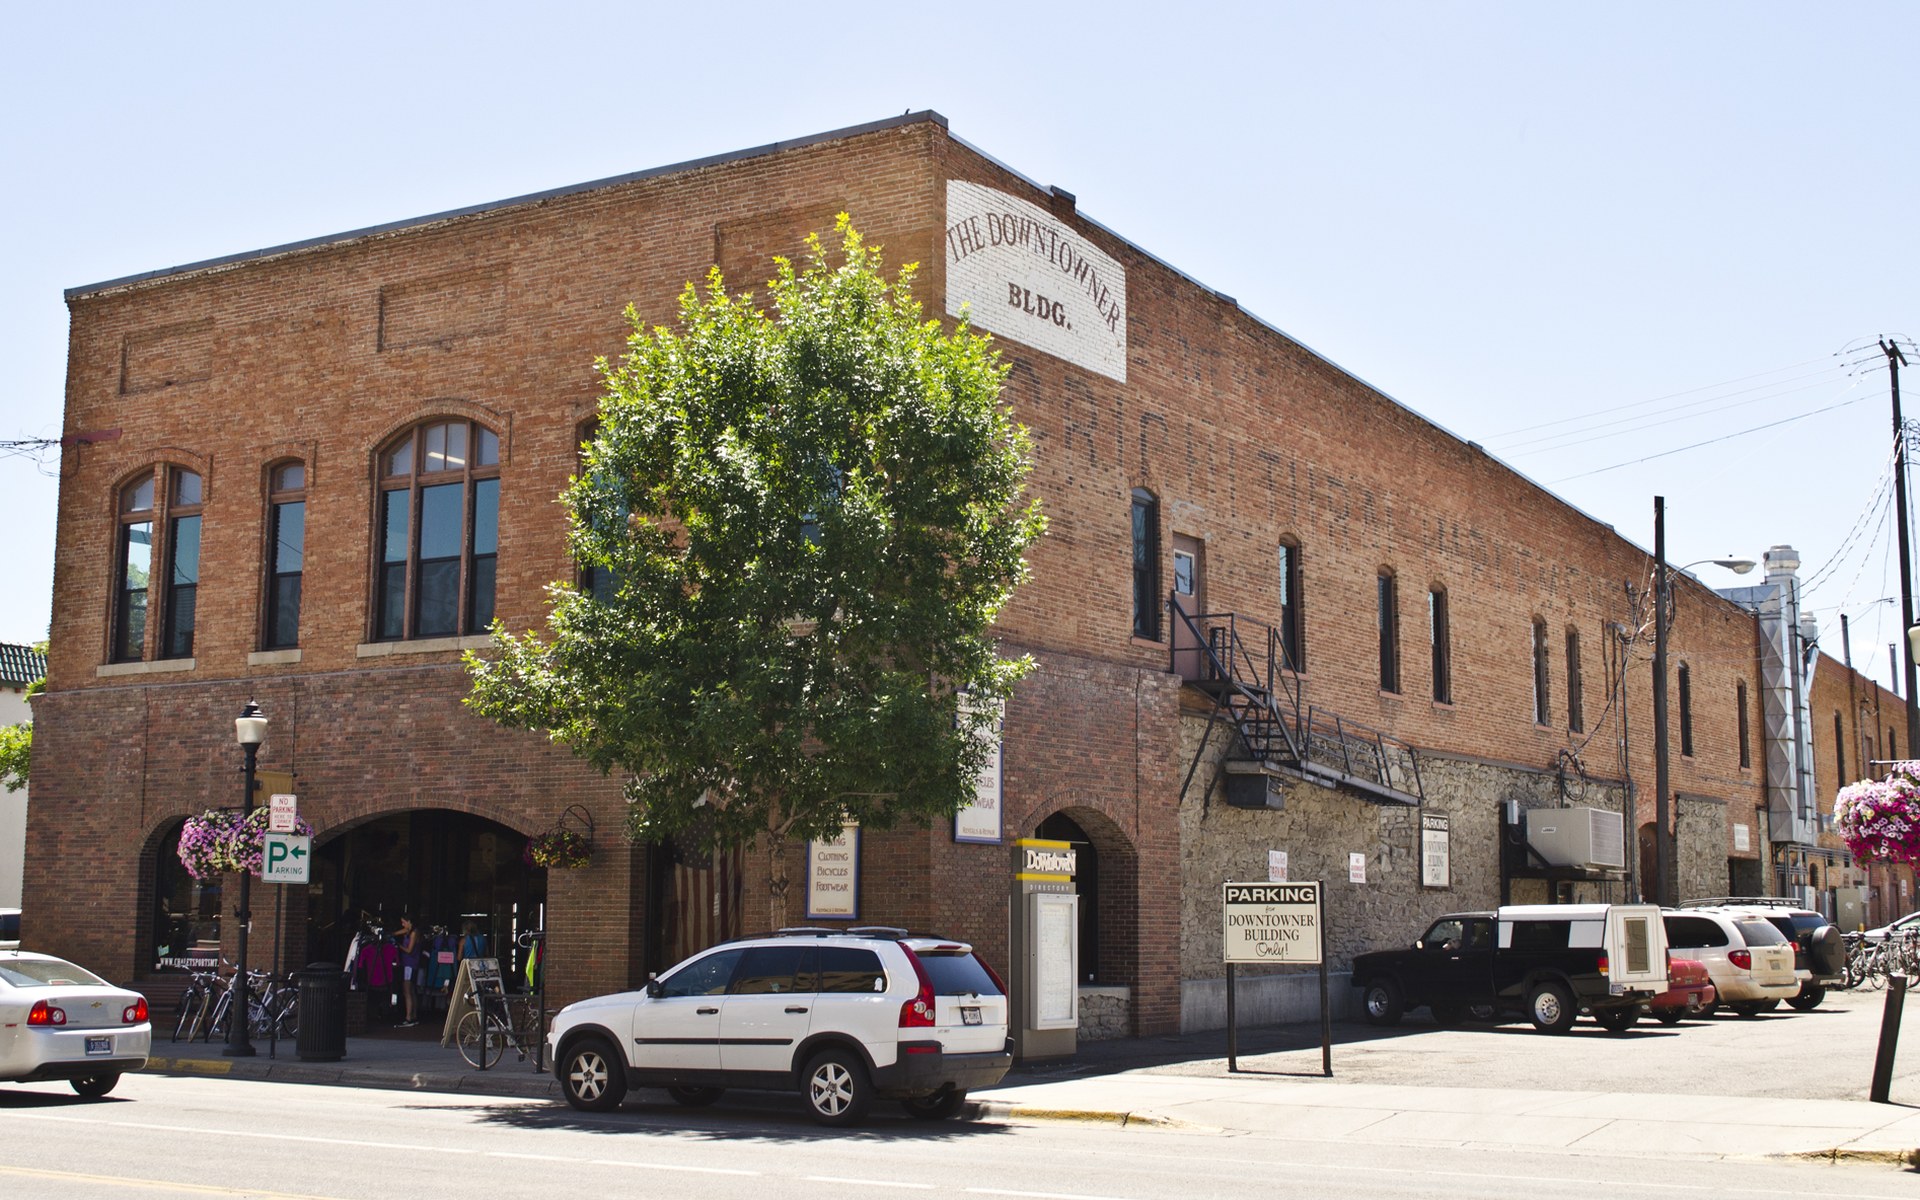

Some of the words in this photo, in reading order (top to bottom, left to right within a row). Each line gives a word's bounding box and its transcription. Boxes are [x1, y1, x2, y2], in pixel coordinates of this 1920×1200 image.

[947, 215, 986, 264] THE
[986, 212, 1120, 333] DOWNTOWNER
[1007, 281, 1073, 330] BLDG.
[278, 798, 289, 806] NO
[272, 806, 294, 814] PARKING
[1423, 817, 1448, 830] PARKING
[820, 837, 846, 847] SING
[817, 851, 849, 862] CLOTHING
[816, 865, 848, 876] BICYCLES
[816, 881, 849, 892] FOOTWEAR
[1227, 888, 1315, 902] PARKING
[1265, 905, 1276, 914] for
[1228, 914, 1315, 927] DOWNTOWNER
[1244, 928, 1300, 941] BUILDING
[1255, 942, 1289, 960] Only!
